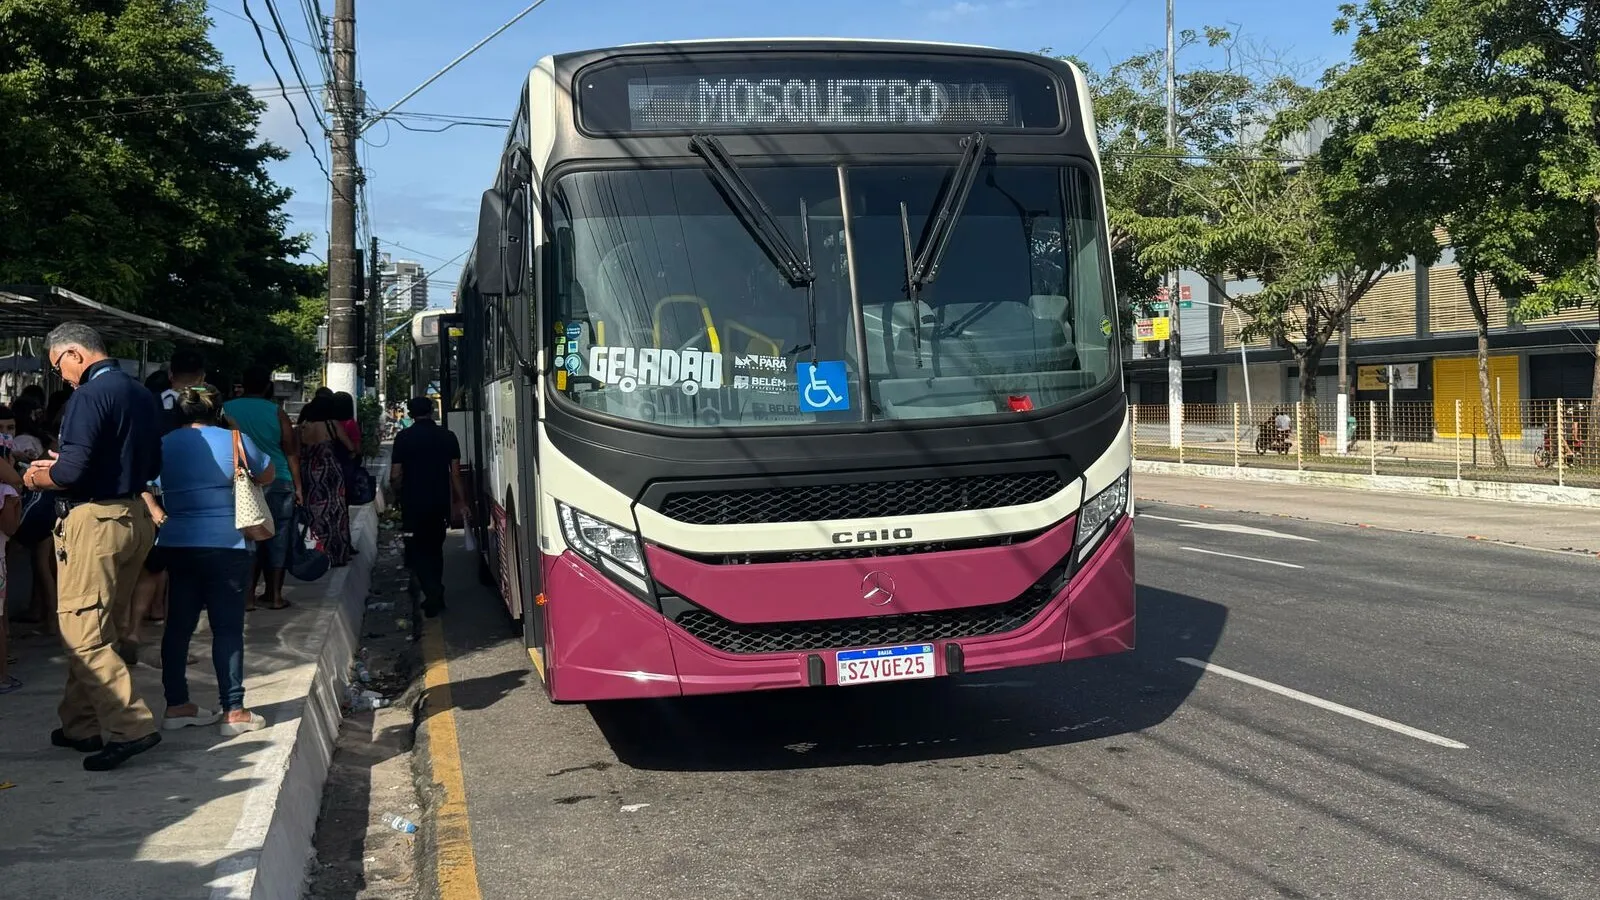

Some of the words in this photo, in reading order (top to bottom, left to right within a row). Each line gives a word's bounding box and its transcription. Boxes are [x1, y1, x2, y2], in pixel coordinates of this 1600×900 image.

[699, 78, 938, 122] MOSQUEIRO
[589, 346, 723, 390] GELADÃO
[751, 377, 787, 387] BELÉM
[831, 528, 913, 544] CAIO
